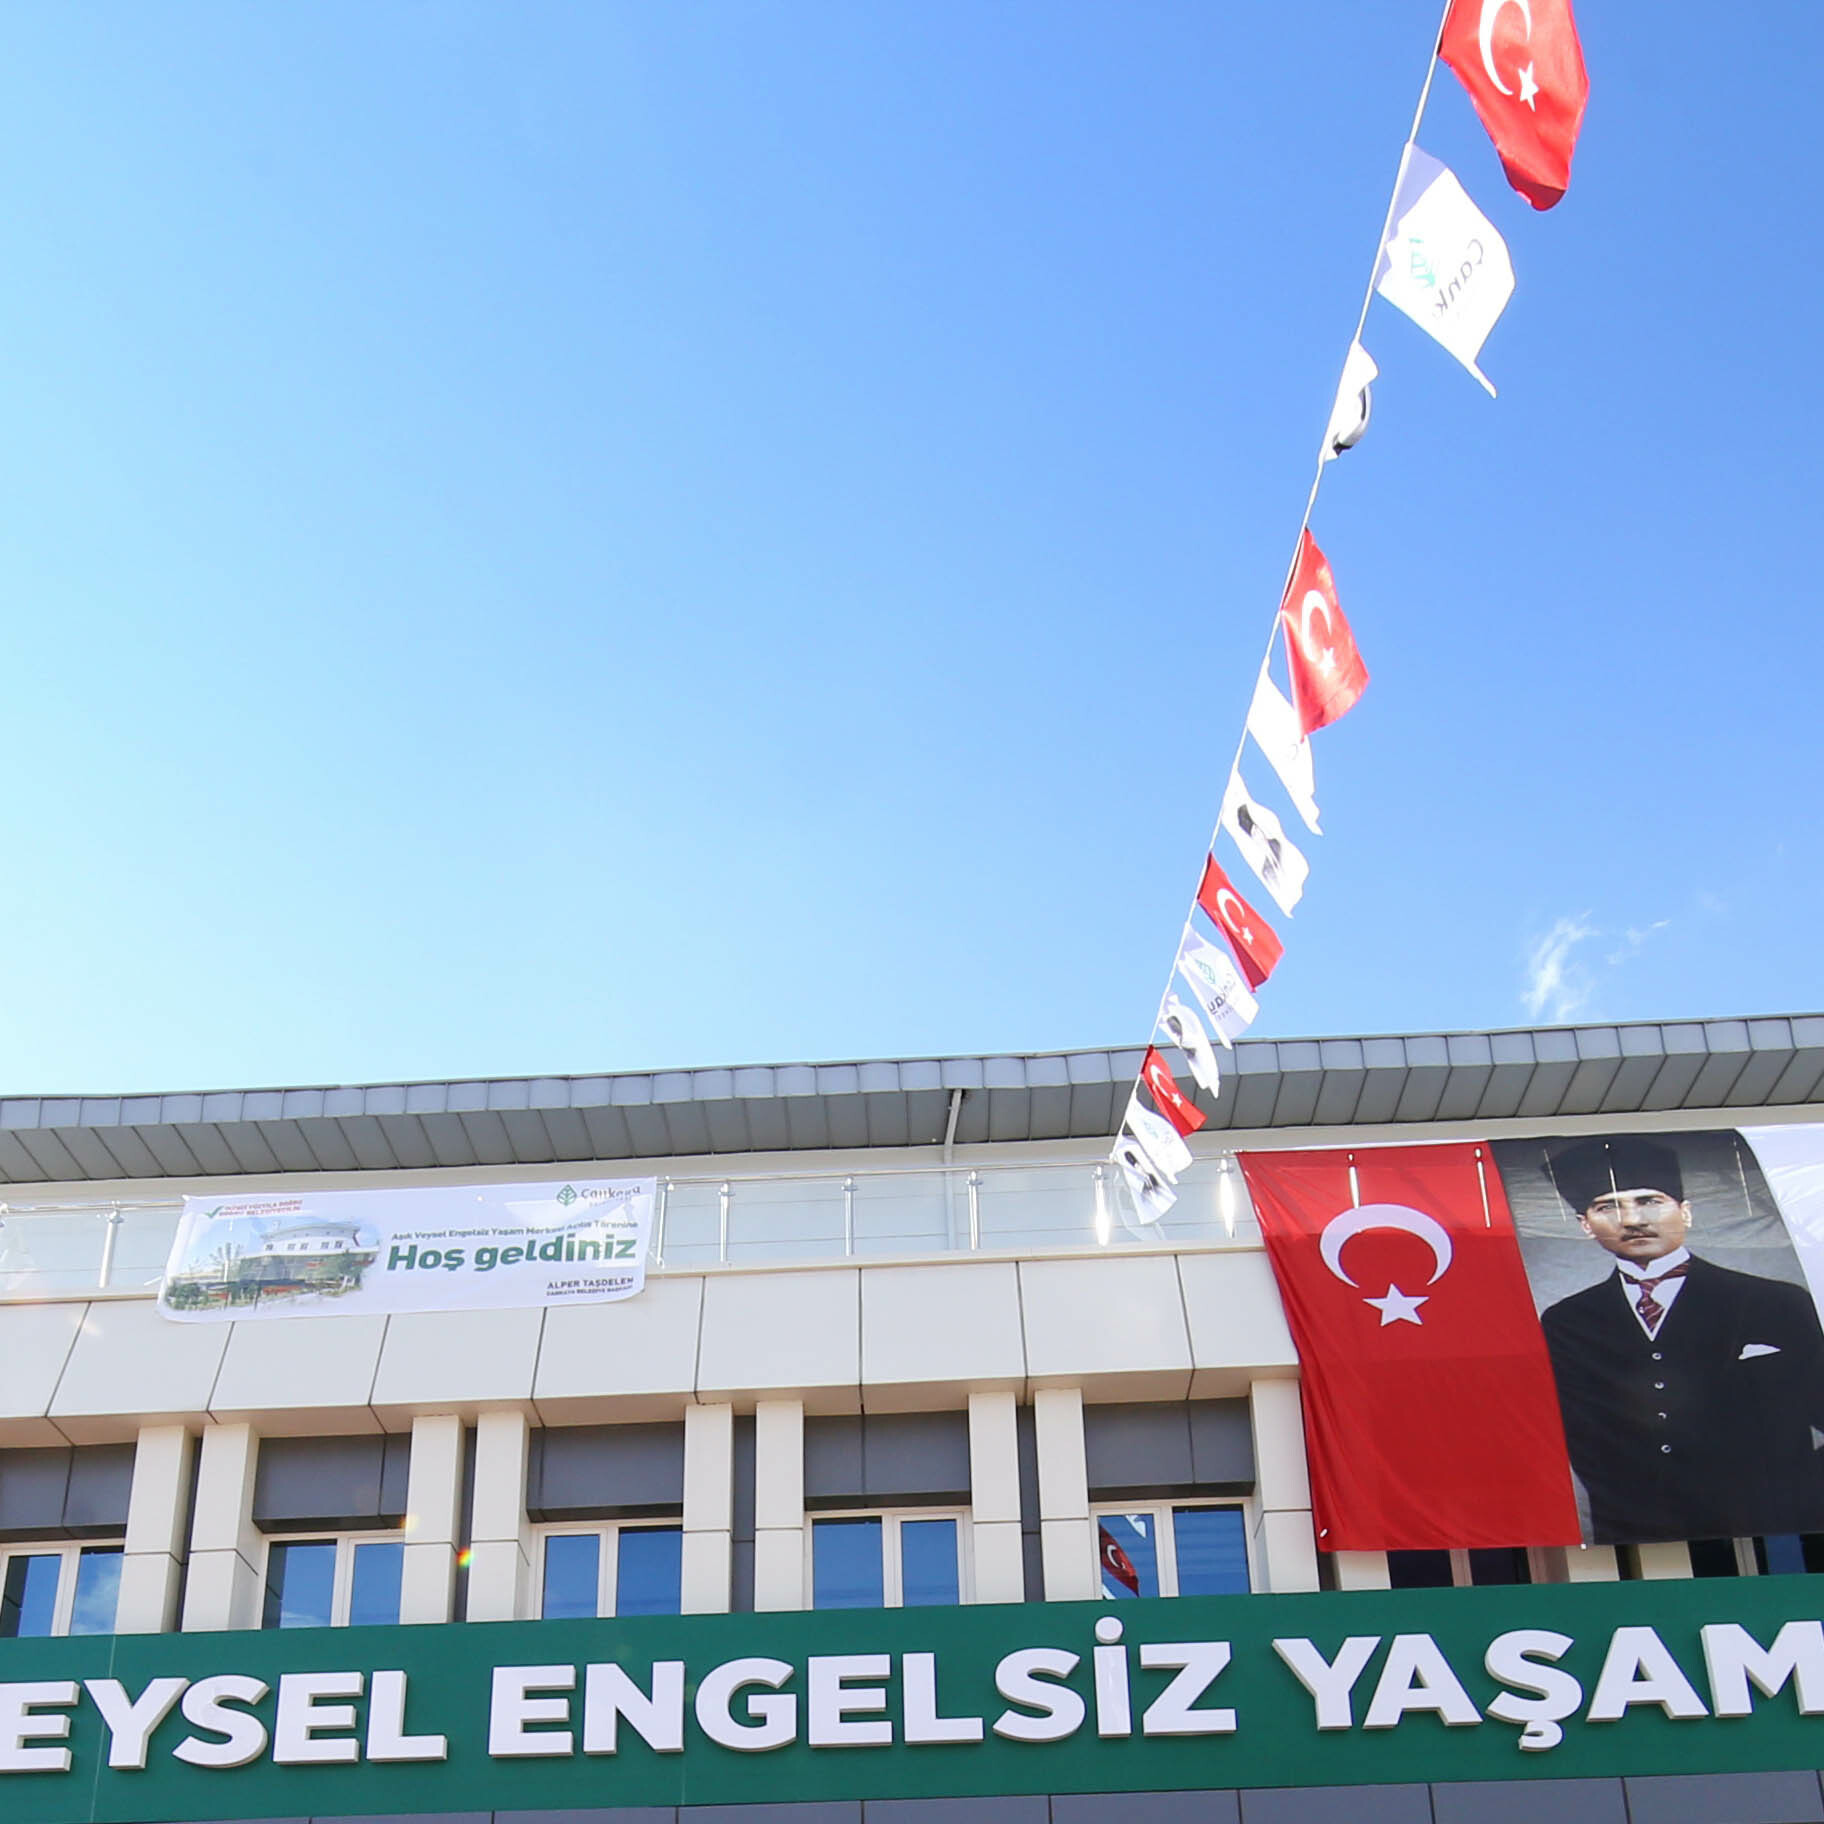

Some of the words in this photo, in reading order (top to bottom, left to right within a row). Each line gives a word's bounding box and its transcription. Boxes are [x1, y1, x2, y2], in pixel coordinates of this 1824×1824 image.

[387, 1244, 466, 1272] Hoş
[473, 1232, 638, 1272] geldiniz
[546, 1279, 581, 1290] ALPER
[582, 1276, 635, 1288] TAŞDELEN
[486, 1616, 1239, 1759] ENGELSİZ
